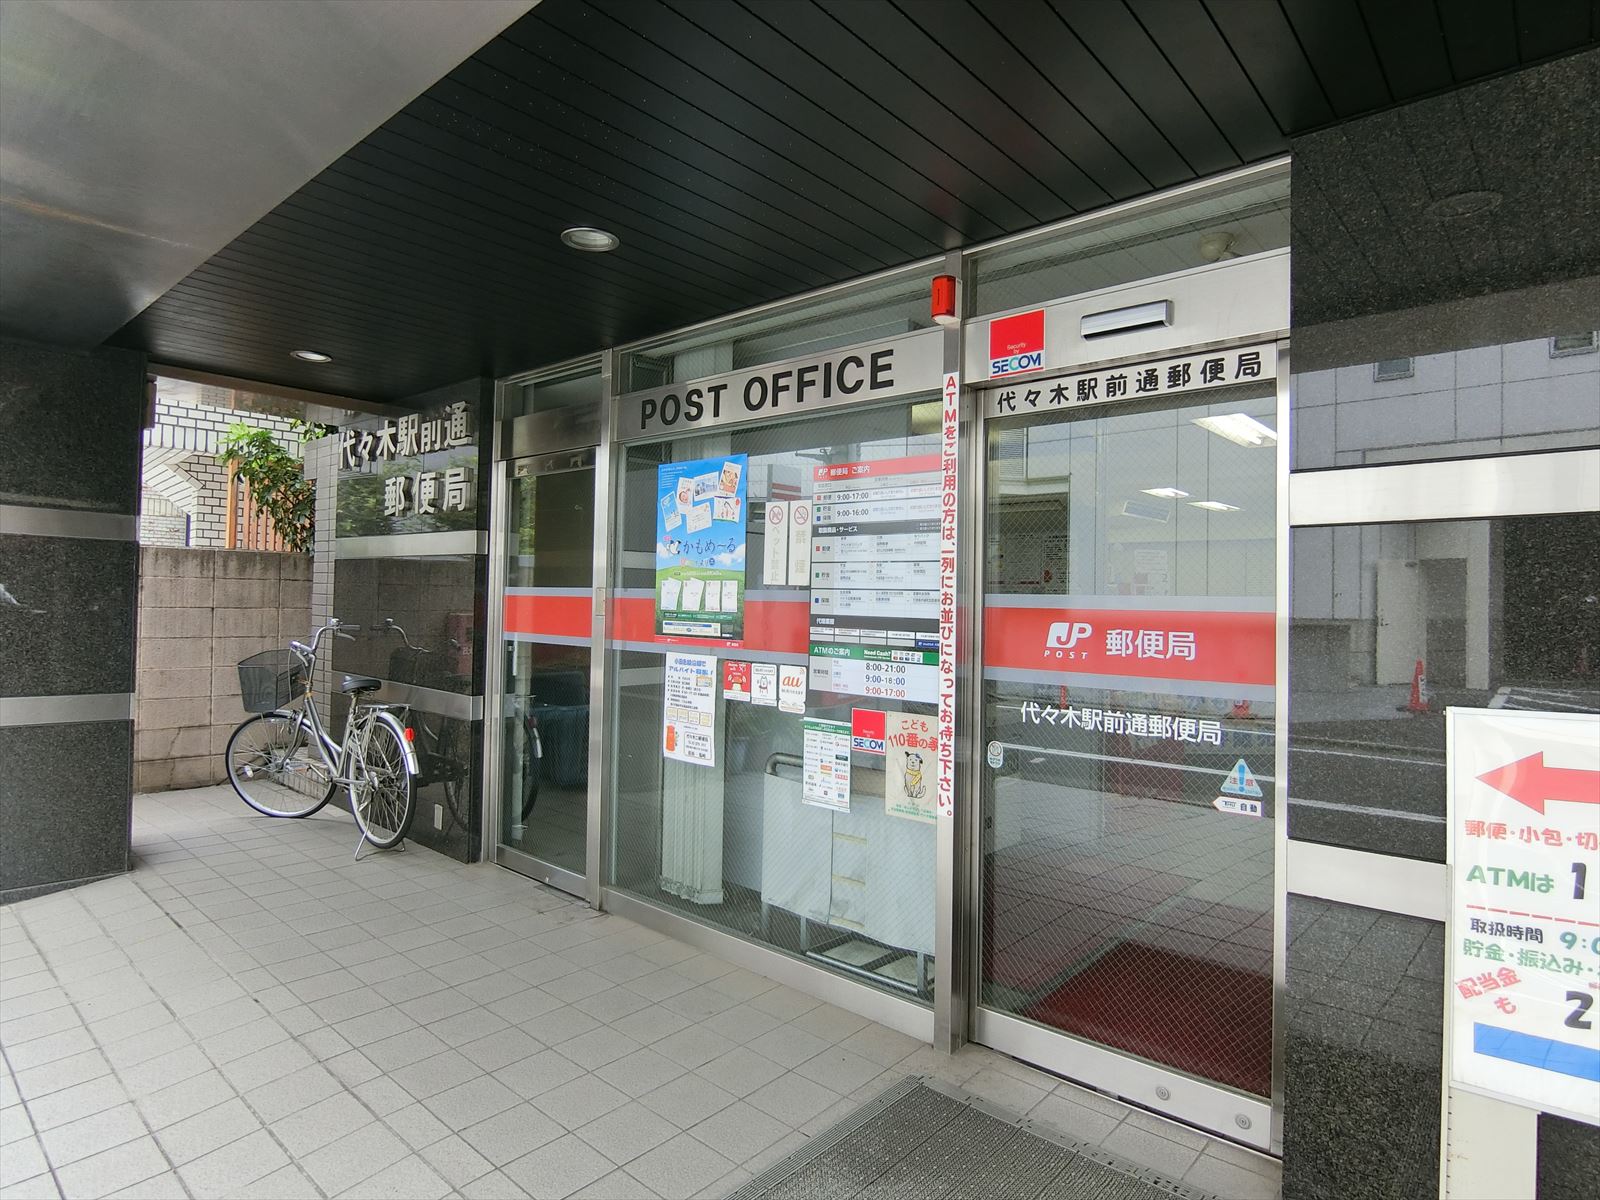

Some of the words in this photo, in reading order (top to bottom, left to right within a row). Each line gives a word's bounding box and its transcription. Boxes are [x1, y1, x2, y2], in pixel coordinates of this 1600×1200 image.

[991, 352, 1042, 375] SECOM
[641, 384, 728, 430] POST
[743, 349, 895, 412] OFFICE
[996, 351, 1263, 414] 代々木駅前通郵便局
[339, 401, 473, 470] 代々木駅前通
[384, 467, 473, 517] 郵便局
[836, 492, 869, 501] 9:00-17:00
[836, 508, 869, 518] 9:00-16:00
[938, 375, 957, 817] ATMをご利用の方は、一列にお並びになってお待ち下さい。
[1043, 649, 1089, 660] POST
[1105, 628, 1197, 661] 郵便局
[865, 662, 906, 674] 8:00-21:00
[865, 674, 906, 686] 9:00-18:00
[782, 676, 803, 688] au
[865, 686, 906, 698] 9:00-17:00
[901, 719, 929, 733] こども
[1020, 701, 1222, 746] 代々木駅前通郵便局
[853, 737, 884, 751] SECOM
[1465, 863, 1555, 894] ATMは
[1469, 917, 1545, 944] 取扱時間
[1462, 937, 1600, 977] 貯金・振込み・
[1455, 965, 1522, 1000] 配当金
[1494, 995, 1518, 1015] も
[1563, 990, 1594, 1030] 2
